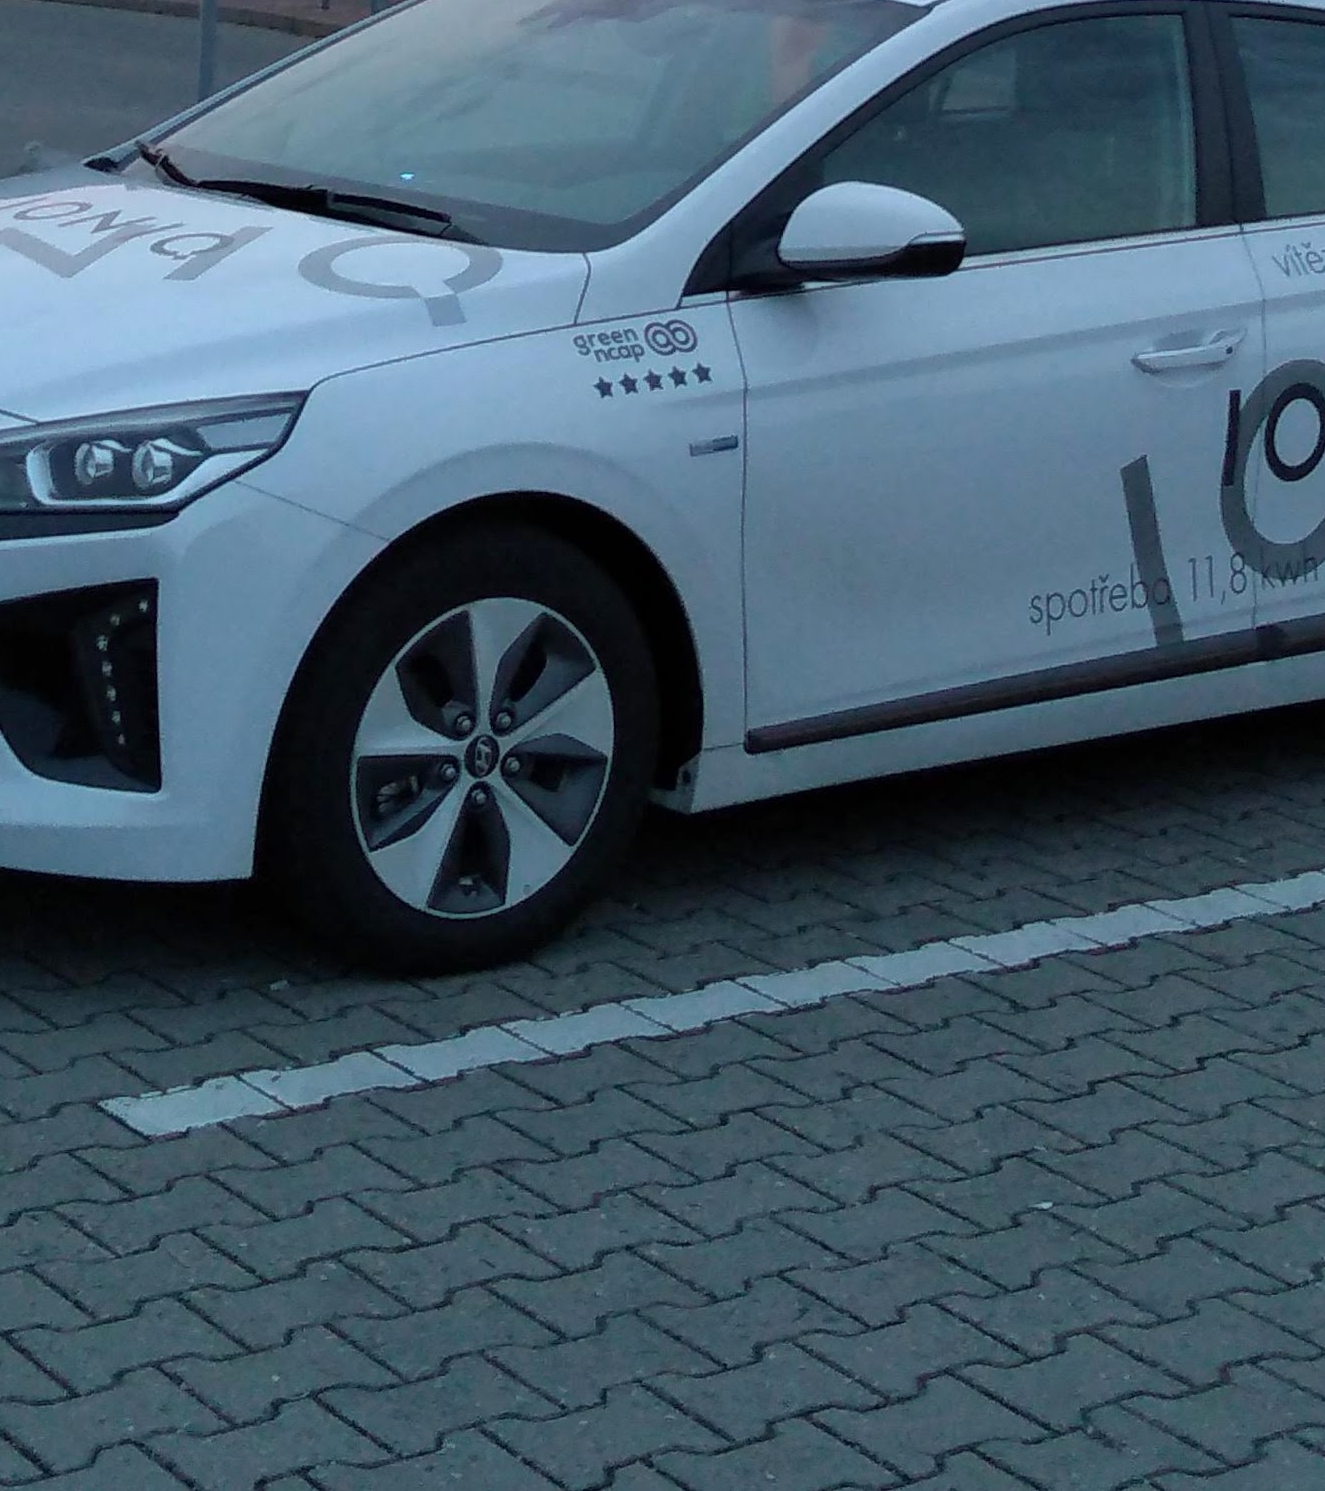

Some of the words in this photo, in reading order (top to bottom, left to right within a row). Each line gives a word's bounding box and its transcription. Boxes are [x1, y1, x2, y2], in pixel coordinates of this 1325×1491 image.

[572, 327, 640, 356] green
[593, 343, 646, 363] ncap
[1187, 551, 1248, 605] 11,8
